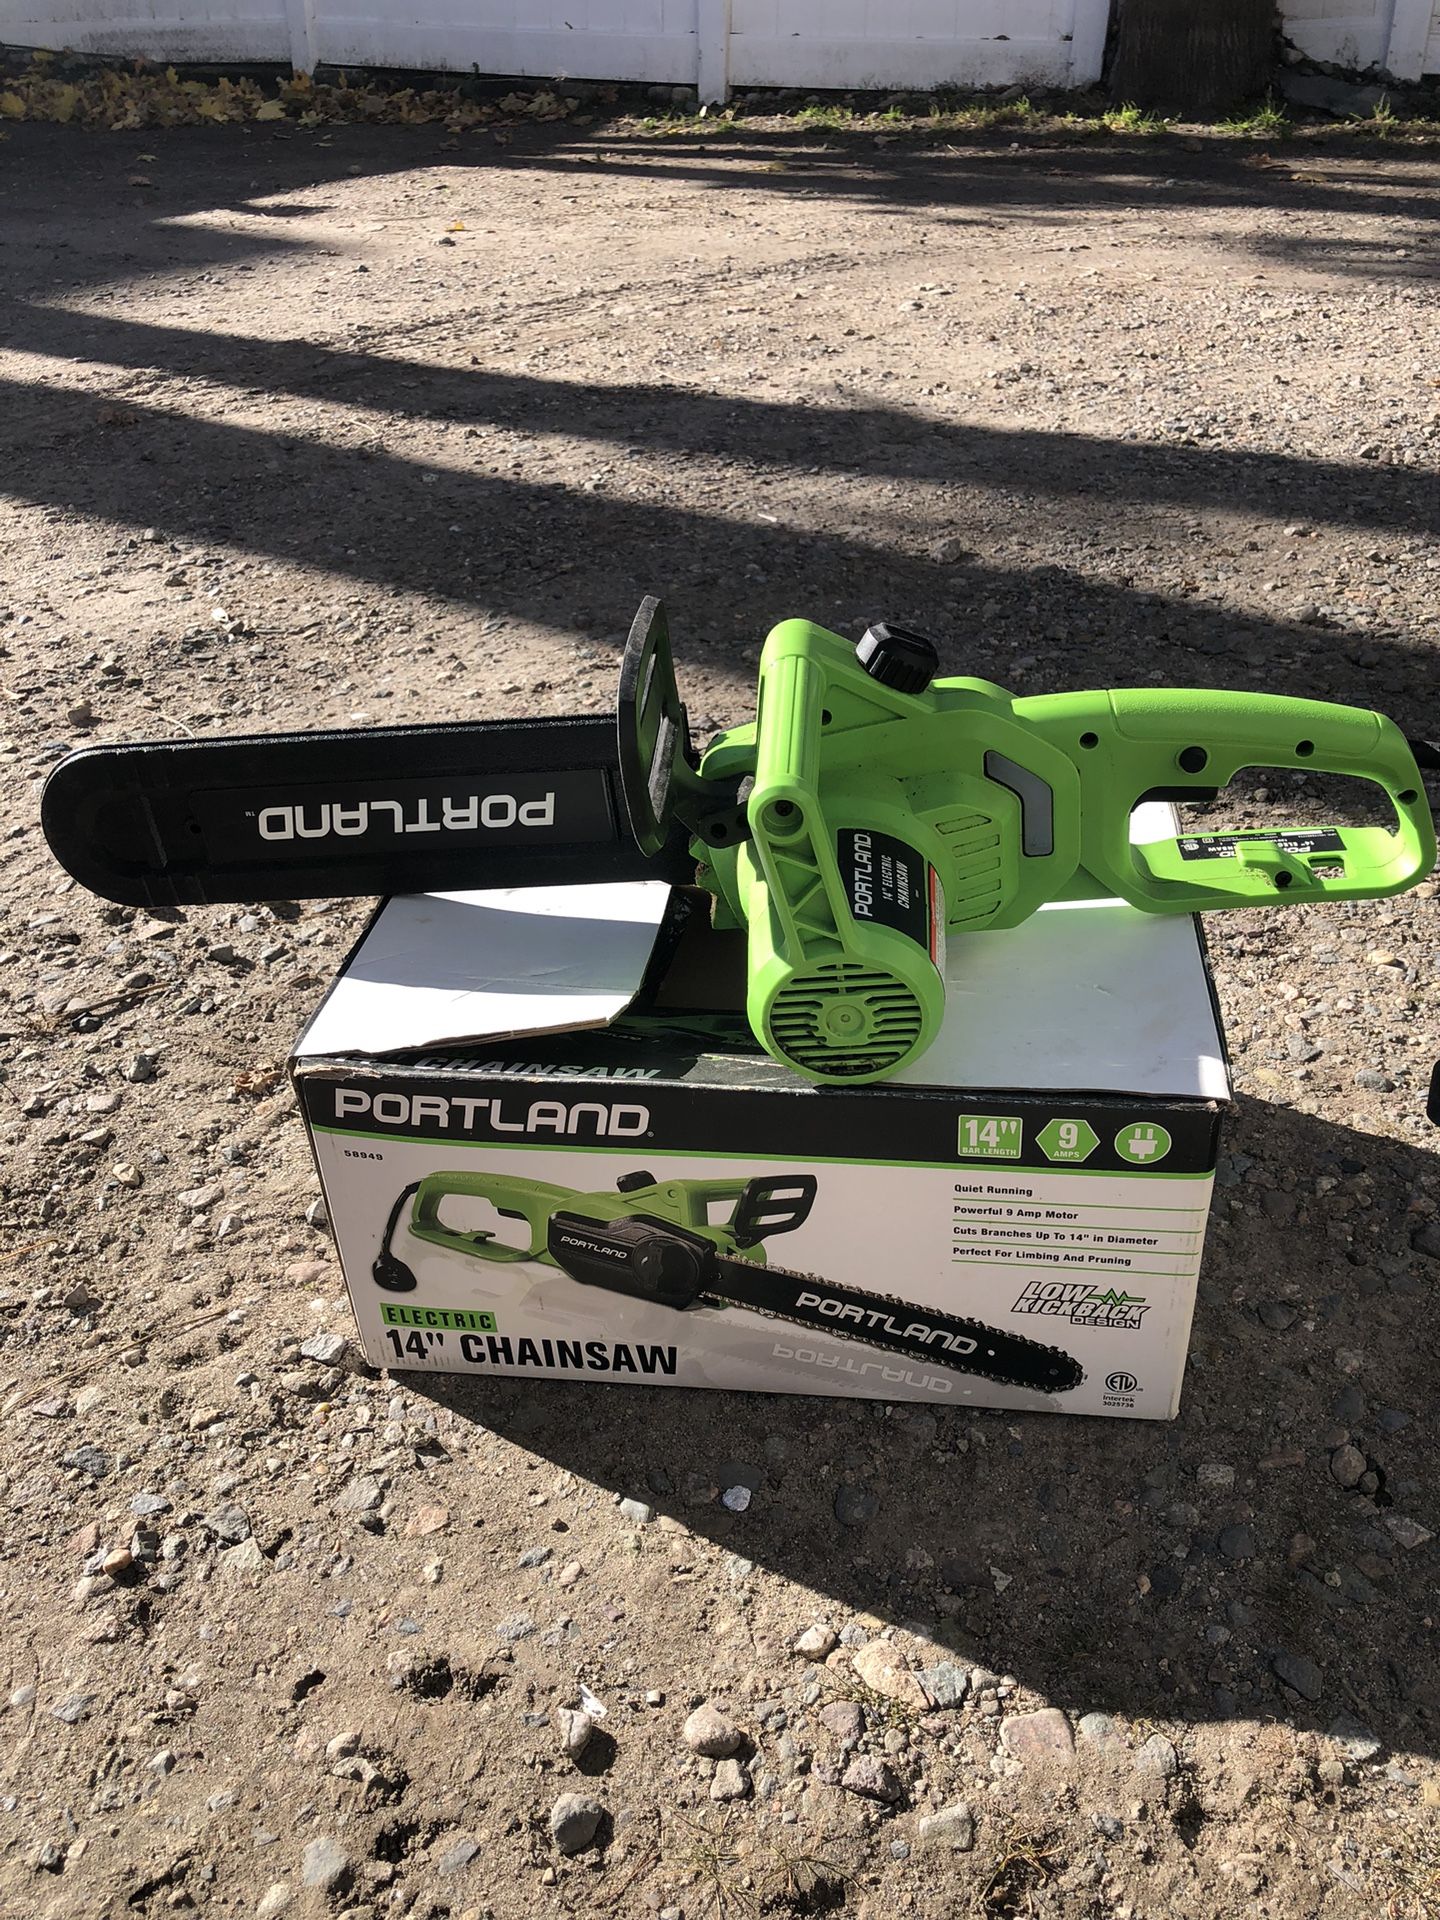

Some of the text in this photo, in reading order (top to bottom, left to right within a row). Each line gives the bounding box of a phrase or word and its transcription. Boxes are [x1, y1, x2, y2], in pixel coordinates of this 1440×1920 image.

[258, 792, 555, 841] PORTLAND
[854, 833, 873, 917] PORTLAND
[881, 855, 894, 901] 14" ELECTRIC
[896, 860, 910, 909] CHAINSAW
[334, 1088, 649, 1137] PORTLAND
[965, 1119, 1017, 1147] 14"
[1058, 1123, 1079, 1149] 9
[344, 1150, 383, 1161] 58949
[983, 1148, 1017, 1156] LENGTH
[954, 1184, 1033, 1197] Quiet Running
[954, 1206, 1078, 1219] Powerful 9 Amp Motor
[561, 1236, 628, 1259] PORTLAND
[953, 1227, 1158, 1245] Cuts Branches Up To 14" in Diameter
[953, 1247, 1131, 1266] Perfect For Limbing And Pruning
[1020, 1281, 1099, 1301] LOW
[387, 1307, 492, 1329] ELECTRIC
[1011, 1298, 1152, 1321] KICKBACK
[795, 1292, 978, 1355] PORTLAND
[1071, 1315, 1139, 1329] DESIGN
[386, 1329, 677, 1375] 14" CHAINSAW
[1102, 1395, 1135, 1403] Intertek
